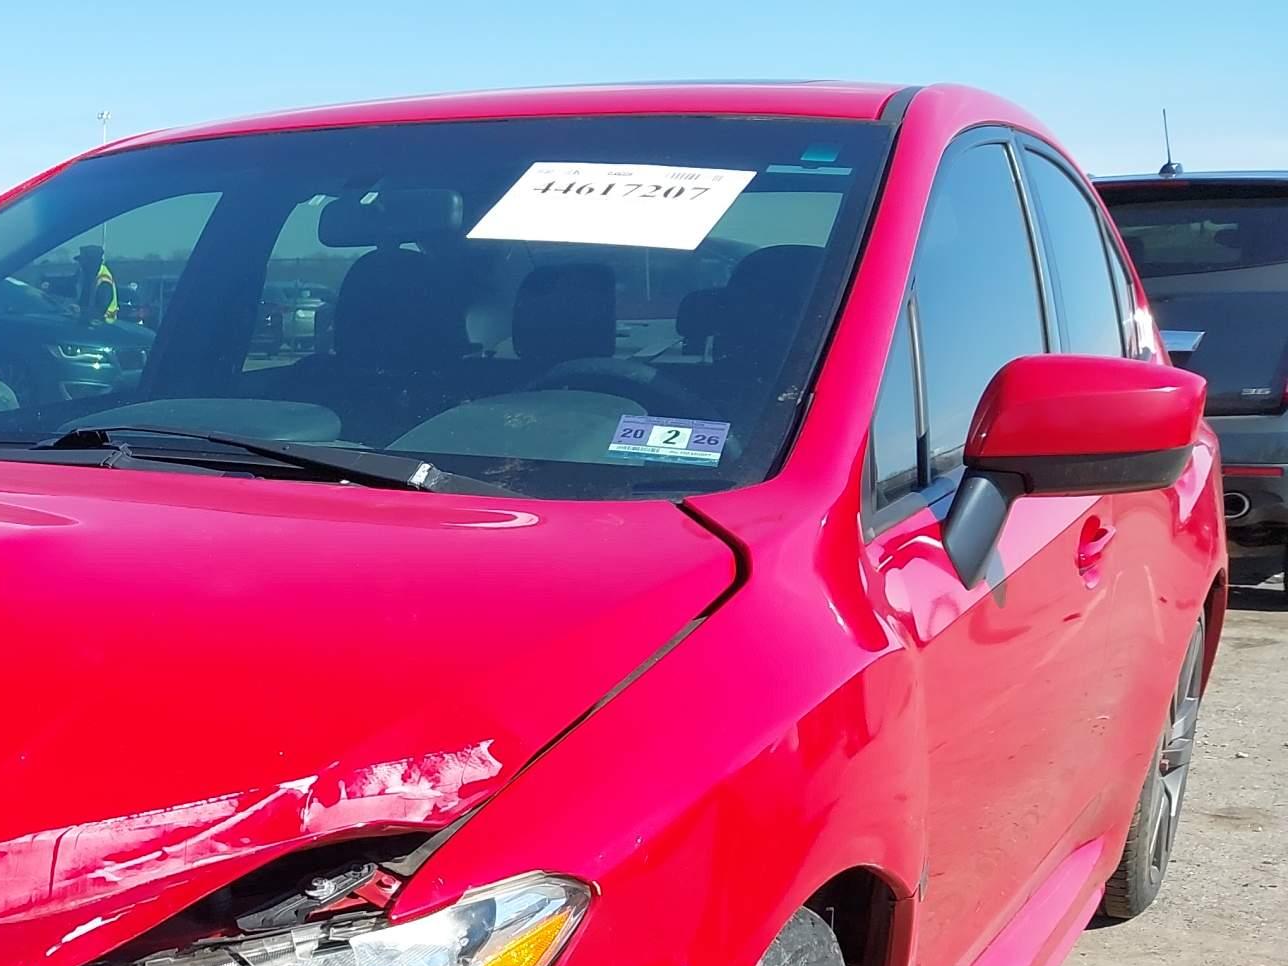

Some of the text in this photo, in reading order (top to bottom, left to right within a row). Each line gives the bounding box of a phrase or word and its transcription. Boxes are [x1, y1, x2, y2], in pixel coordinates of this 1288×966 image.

[533, 181, 710, 200] 44617207
[620, 428, 720, 446] 20 2 26
